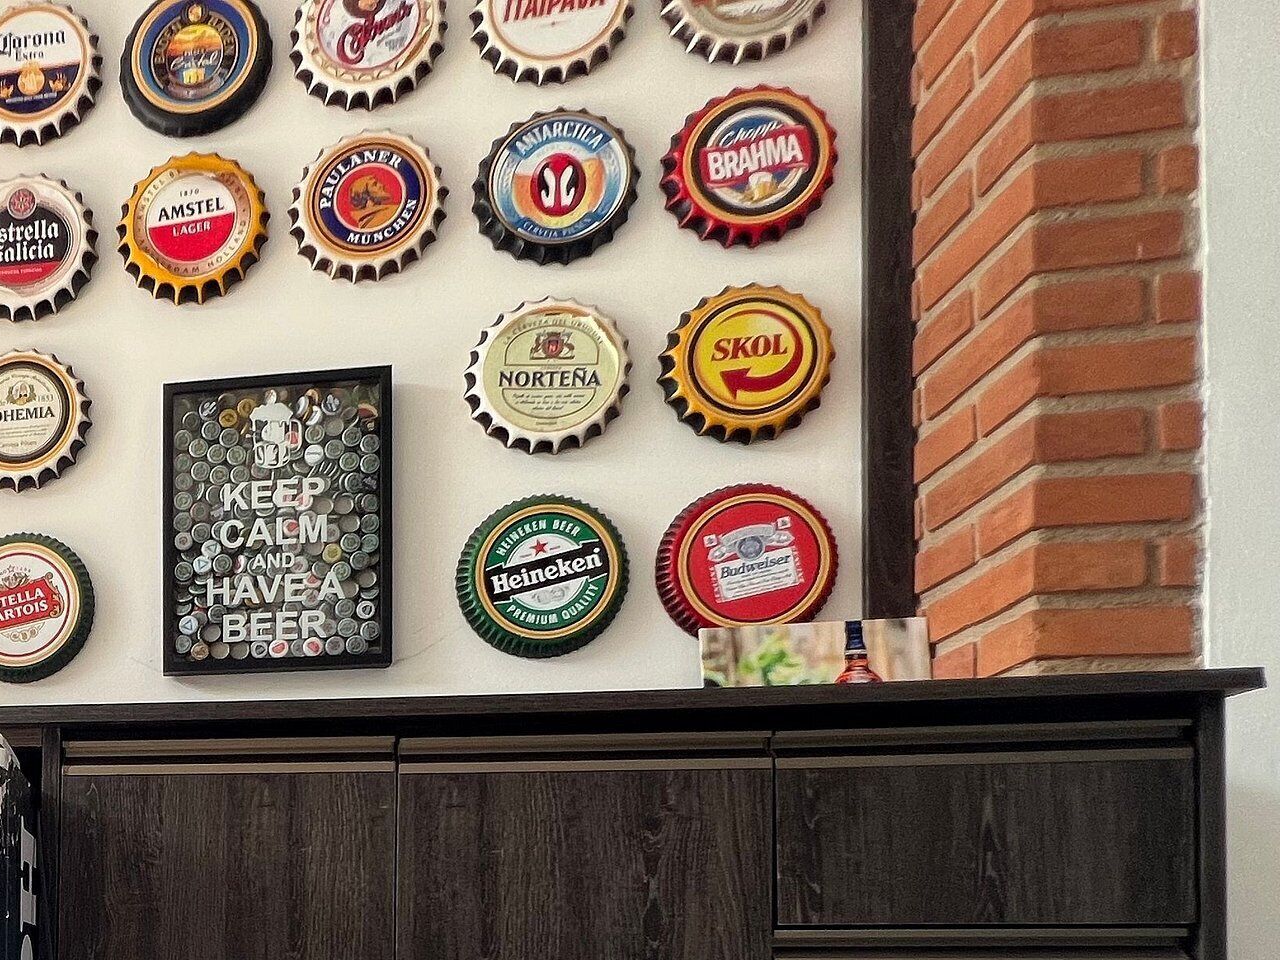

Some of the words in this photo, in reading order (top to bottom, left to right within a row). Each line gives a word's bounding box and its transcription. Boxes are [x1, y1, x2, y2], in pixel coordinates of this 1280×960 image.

[515, 121, 605, 156] ANTARCTICA
[707, 133, 804, 181] BRAHMA
[320, 150, 402, 209] PAULANER
[159, 197, 224, 222] AMSTEL
[173, 220, 211, 237] LAGER
[711, 333, 788, 362] SKOL
[498, 367, 601, 388] NORTEÑA
[223, 477, 325, 511] KEEP
[220, 514, 328, 548] CALM
[496, 519, 547, 556] HEINEKEN
[552, 519, 580, 537] BEER
[252, 552, 295, 570] AND
[490, 547, 602, 594] Heineken
[720, 555, 791, 579] Budweiser
[207, 572, 310, 606] HAVE
[320, 571, 346, 600] A
[507, 604, 558, 624] PREMIUM
[561, 583, 598, 620] QUALITY
[223, 611, 326, 643] BEER
